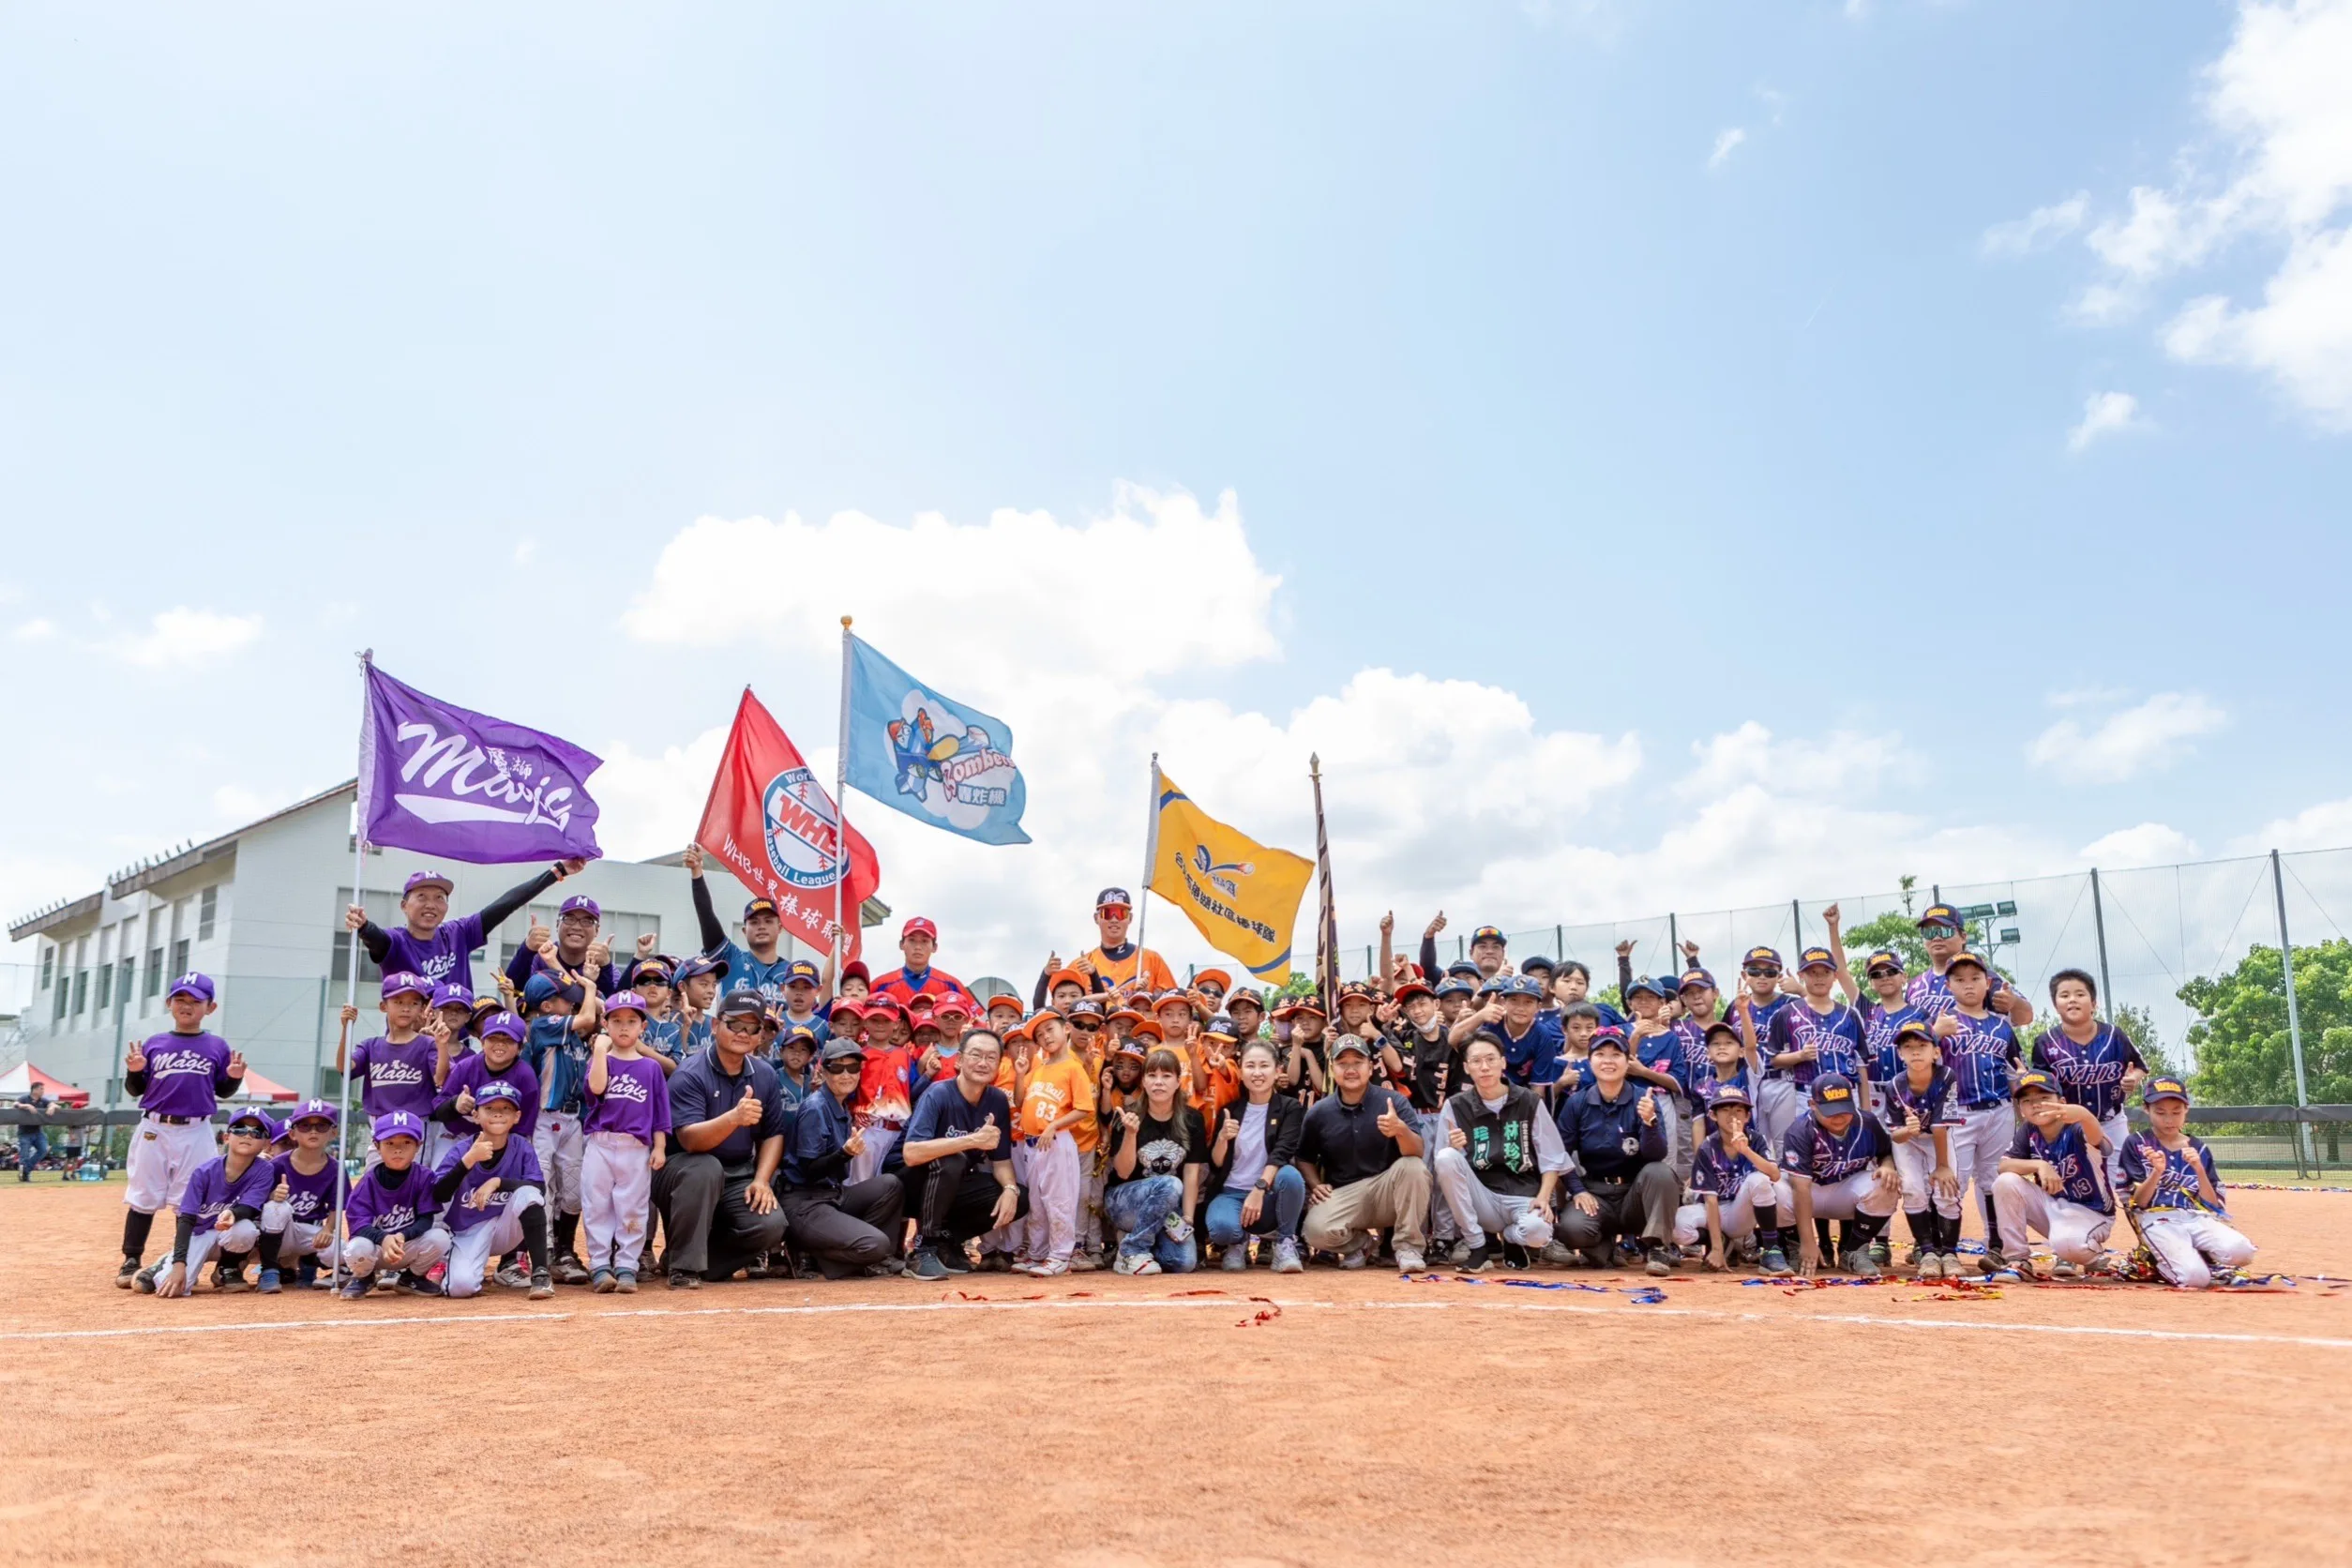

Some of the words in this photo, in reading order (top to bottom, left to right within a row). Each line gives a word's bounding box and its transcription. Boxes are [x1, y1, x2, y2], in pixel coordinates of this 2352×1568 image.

[785, 771, 818, 784] Wor
[767, 828, 789, 878] Baseball
[793, 872, 836, 886] League
[425, 870, 437, 879] M
[576, 895, 588, 907] M
[182, 972, 198, 984] M
[400, 973, 415, 986] M
[448, 984, 461, 996] M
[618, 991, 632, 1003] M
[496, 1012, 511, 1025] M
[153, 1052, 213, 1074] Magic
[369, 1062, 423, 1081] Magic
[2050, 1057, 2124, 1085] WHB
[1823, 1088, 1848, 1102] WHB
[246, 1106, 260, 1115] M
[308, 1098, 323, 1112] M
[1035, 1100, 1058, 1122] 83
[393, 1112, 407, 1125] M
